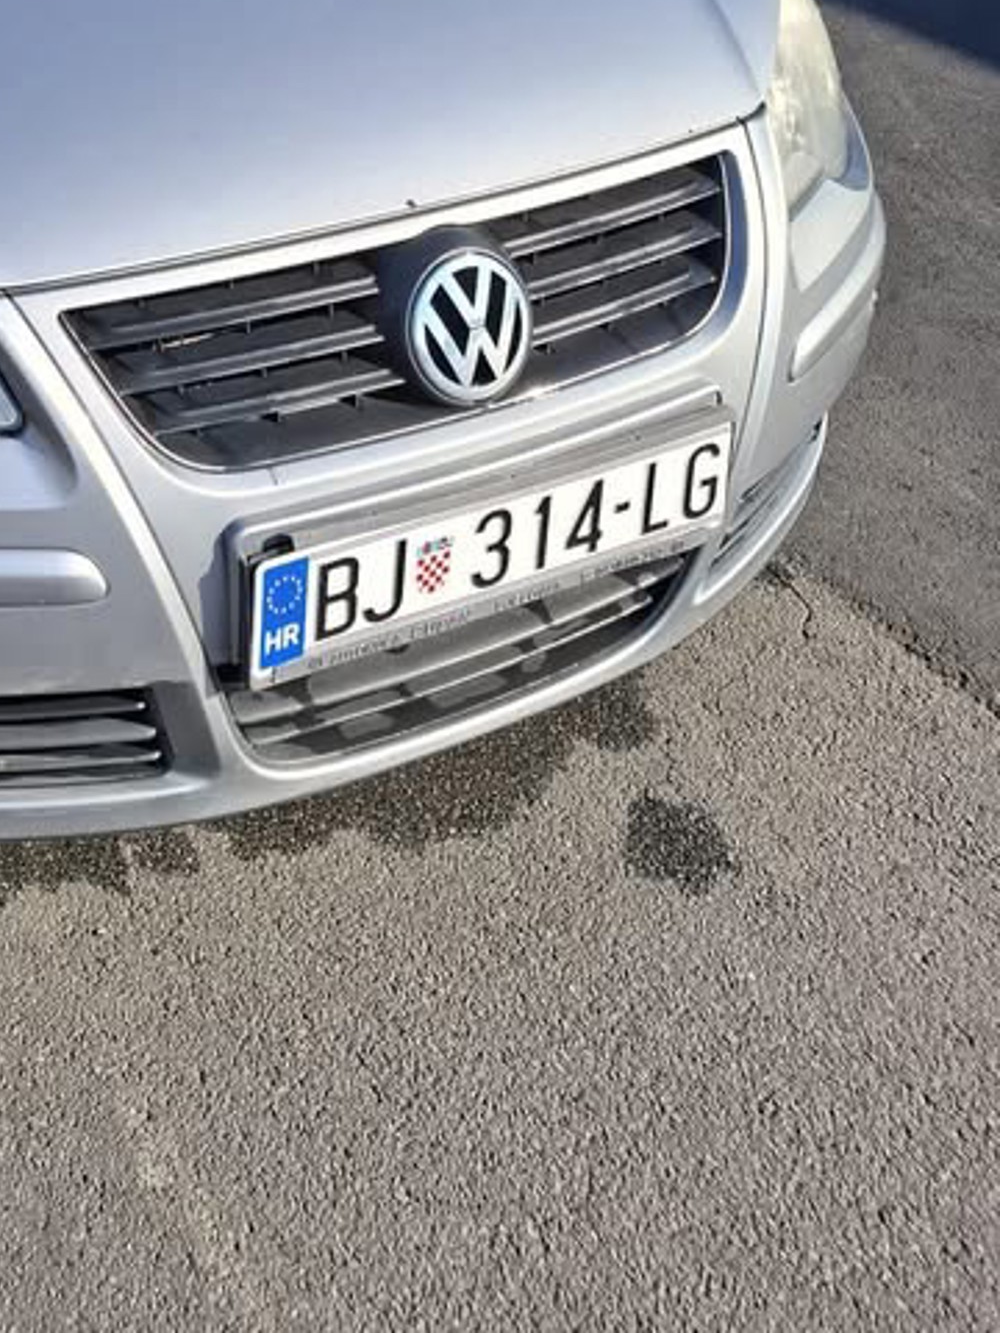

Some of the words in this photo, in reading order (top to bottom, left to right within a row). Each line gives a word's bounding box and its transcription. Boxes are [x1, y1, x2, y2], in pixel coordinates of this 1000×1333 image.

[412, 252, 526, 400] VW
[316, 539, 407, 641] BJ
[471, 443, 720, 588] 314-LG
[265, 623, 300, 655] HR
